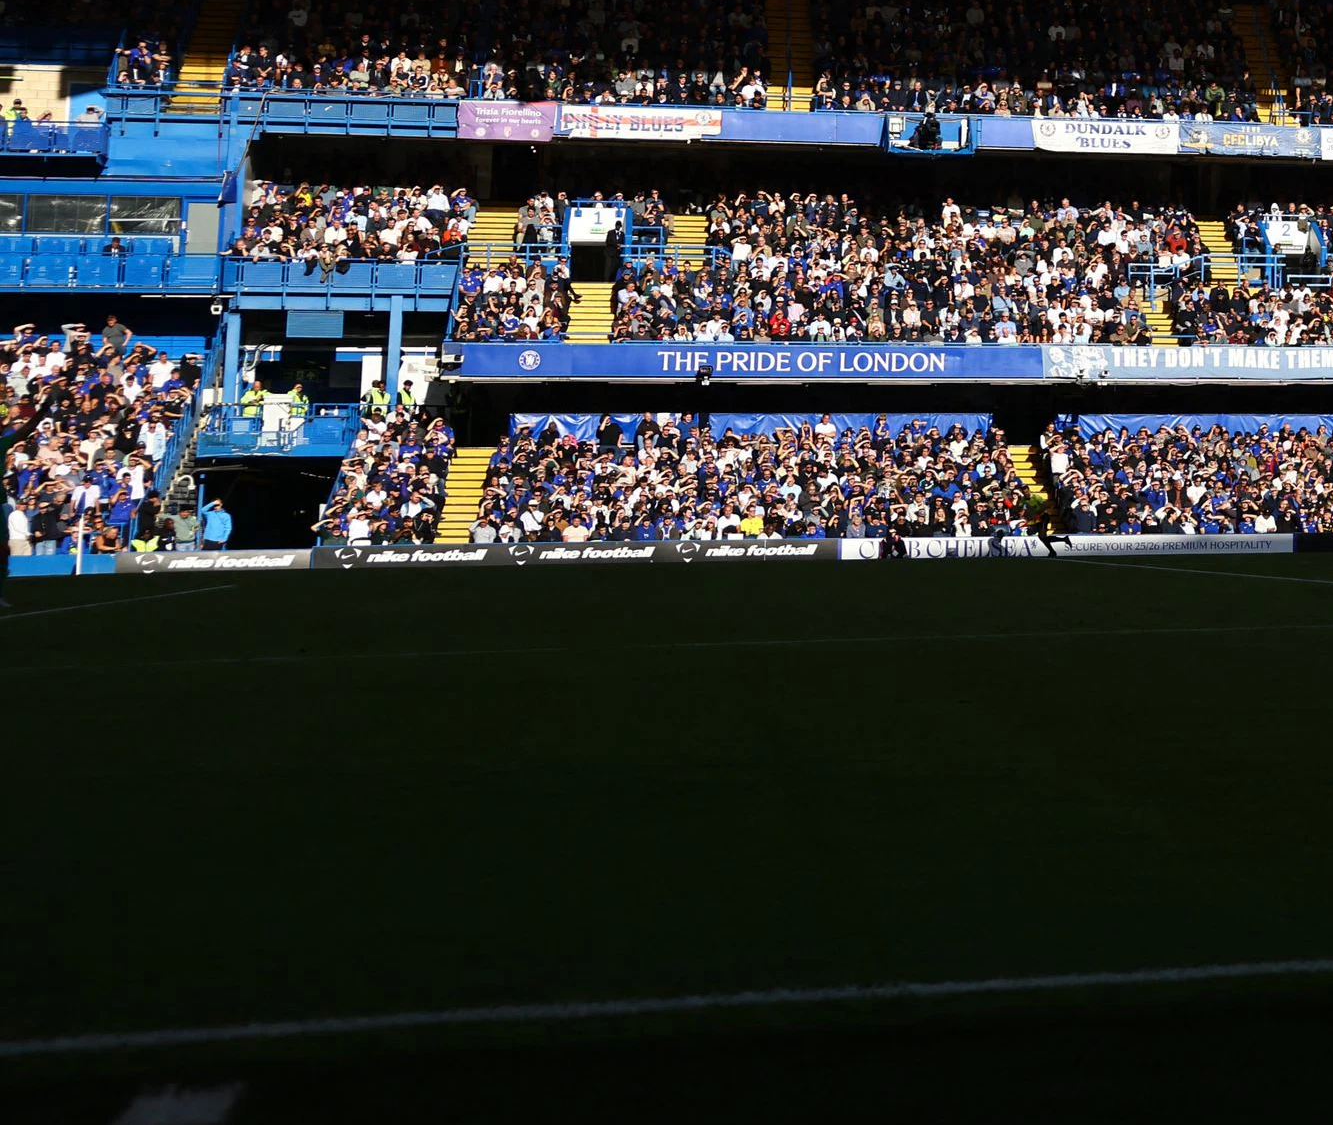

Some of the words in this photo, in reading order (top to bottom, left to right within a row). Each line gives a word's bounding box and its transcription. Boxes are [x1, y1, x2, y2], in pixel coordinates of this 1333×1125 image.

[475, 107, 499, 115] Trizia
[501, 108, 542, 117] Fiorellino
[629, 115, 684, 132] BLUES
[1064, 122, 1147, 136] DUNDALK
[1076, 137, 1132, 149] BLUES
[594, 211, 603, 225] 1
[1282, 223, 1291, 237] 2
[657, 350, 709, 372] THE
[715, 351, 791, 372] PRIDE
[797, 351, 833, 372] OF
[839, 351, 946, 372] LONDON
[1111, 346, 1158, 368] THEY
[1164, 347, 1221, 369] DON'T
[1227, 348, 1280, 370] MAKE
[539, 546, 580, 560] nike
[581, 545, 656, 560] football
[705, 544, 746, 557] nike
[746, 543, 819, 557] football
[926, 538, 1032, 558] CHELSEA
[1064, 542, 1103, 552] SECURE
[1104, 542, 1133, 552] YOUR
[1135, 541, 1160, 552] 25/26
[1162, 541, 1208, 551] PREMIUM
[1210, 540, 1272, 550] HOSPITALITY
[168, 556, 214, 569] nike
[214, 554, 297, 568] football
[366, 549, 411, 563] nike
[411, 548, 489, 562] football
